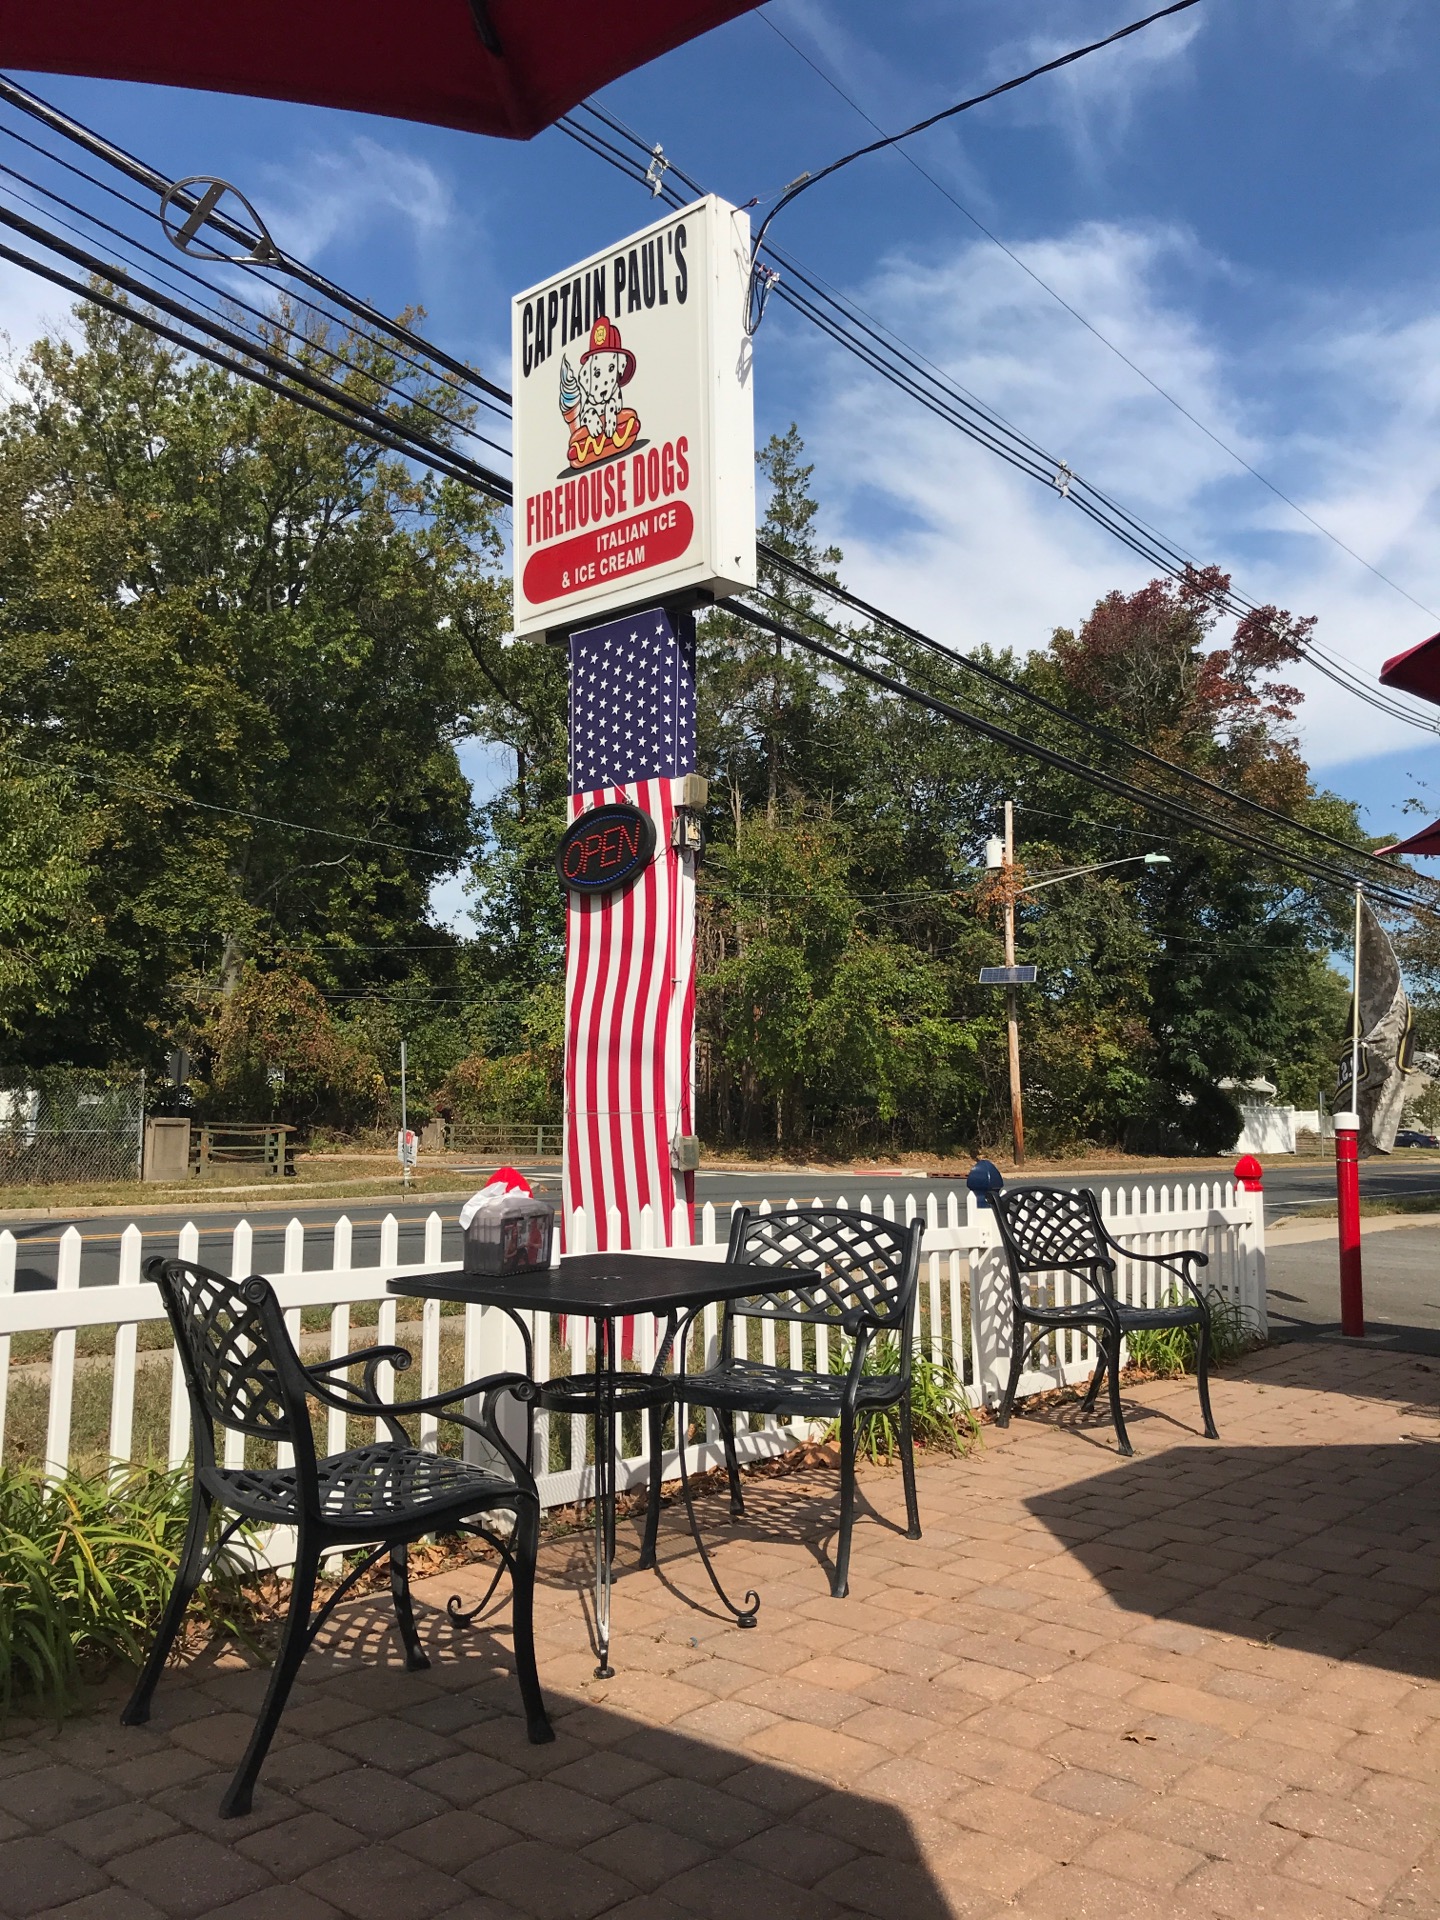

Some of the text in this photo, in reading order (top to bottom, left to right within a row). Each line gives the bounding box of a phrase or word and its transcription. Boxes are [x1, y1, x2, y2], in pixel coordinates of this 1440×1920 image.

[522, 223, 688, 378] CAPTAIN PAUL'S
[526, 435, 689, 547] FIREHOUSE DOGS
[596, 508, 677, 553] ITALIAN ICE
[561, 544, 645, 589] & ICE CREAM
[563, 819, 640, 878] OPEN
